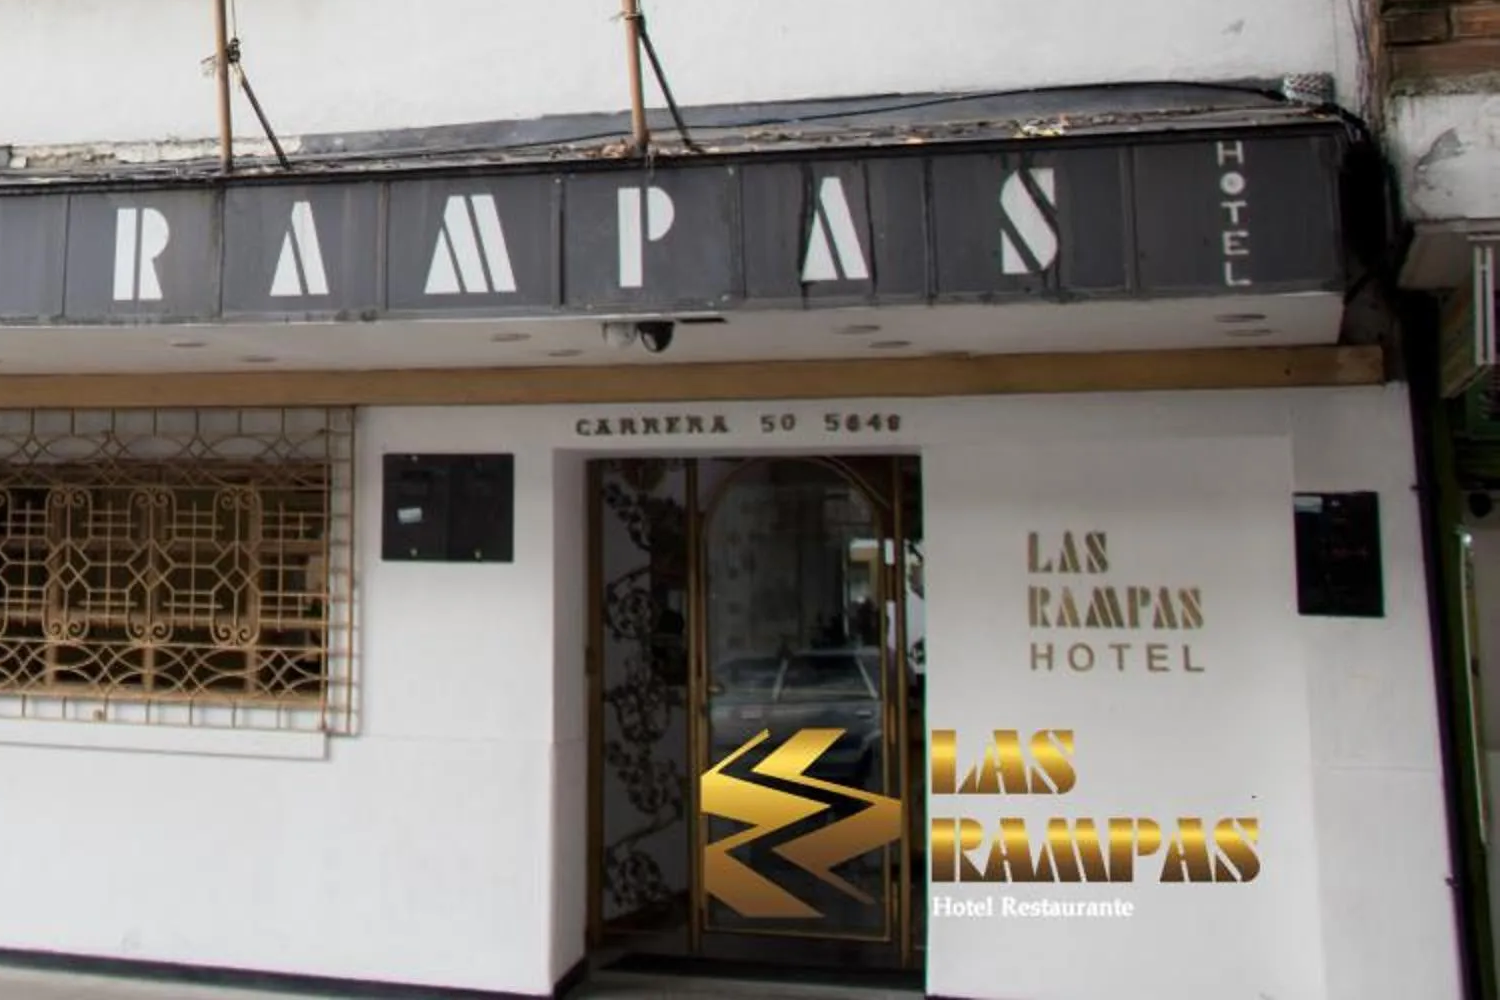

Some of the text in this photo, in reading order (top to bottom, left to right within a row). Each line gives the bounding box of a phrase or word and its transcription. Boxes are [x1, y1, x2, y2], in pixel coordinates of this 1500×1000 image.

[113, 168, 1057, 301] RAMPAS
[1215, 140, 1252, 288] HOTEL
[575, 416, 729, 436] CARRERA
[760, 413, 797, 432] 50
[1027, 532, 1109, 573] LAS
[1027, 586, 1204, 629] RAMPAS
[1030, 642, 1205, 672] HOTEL
